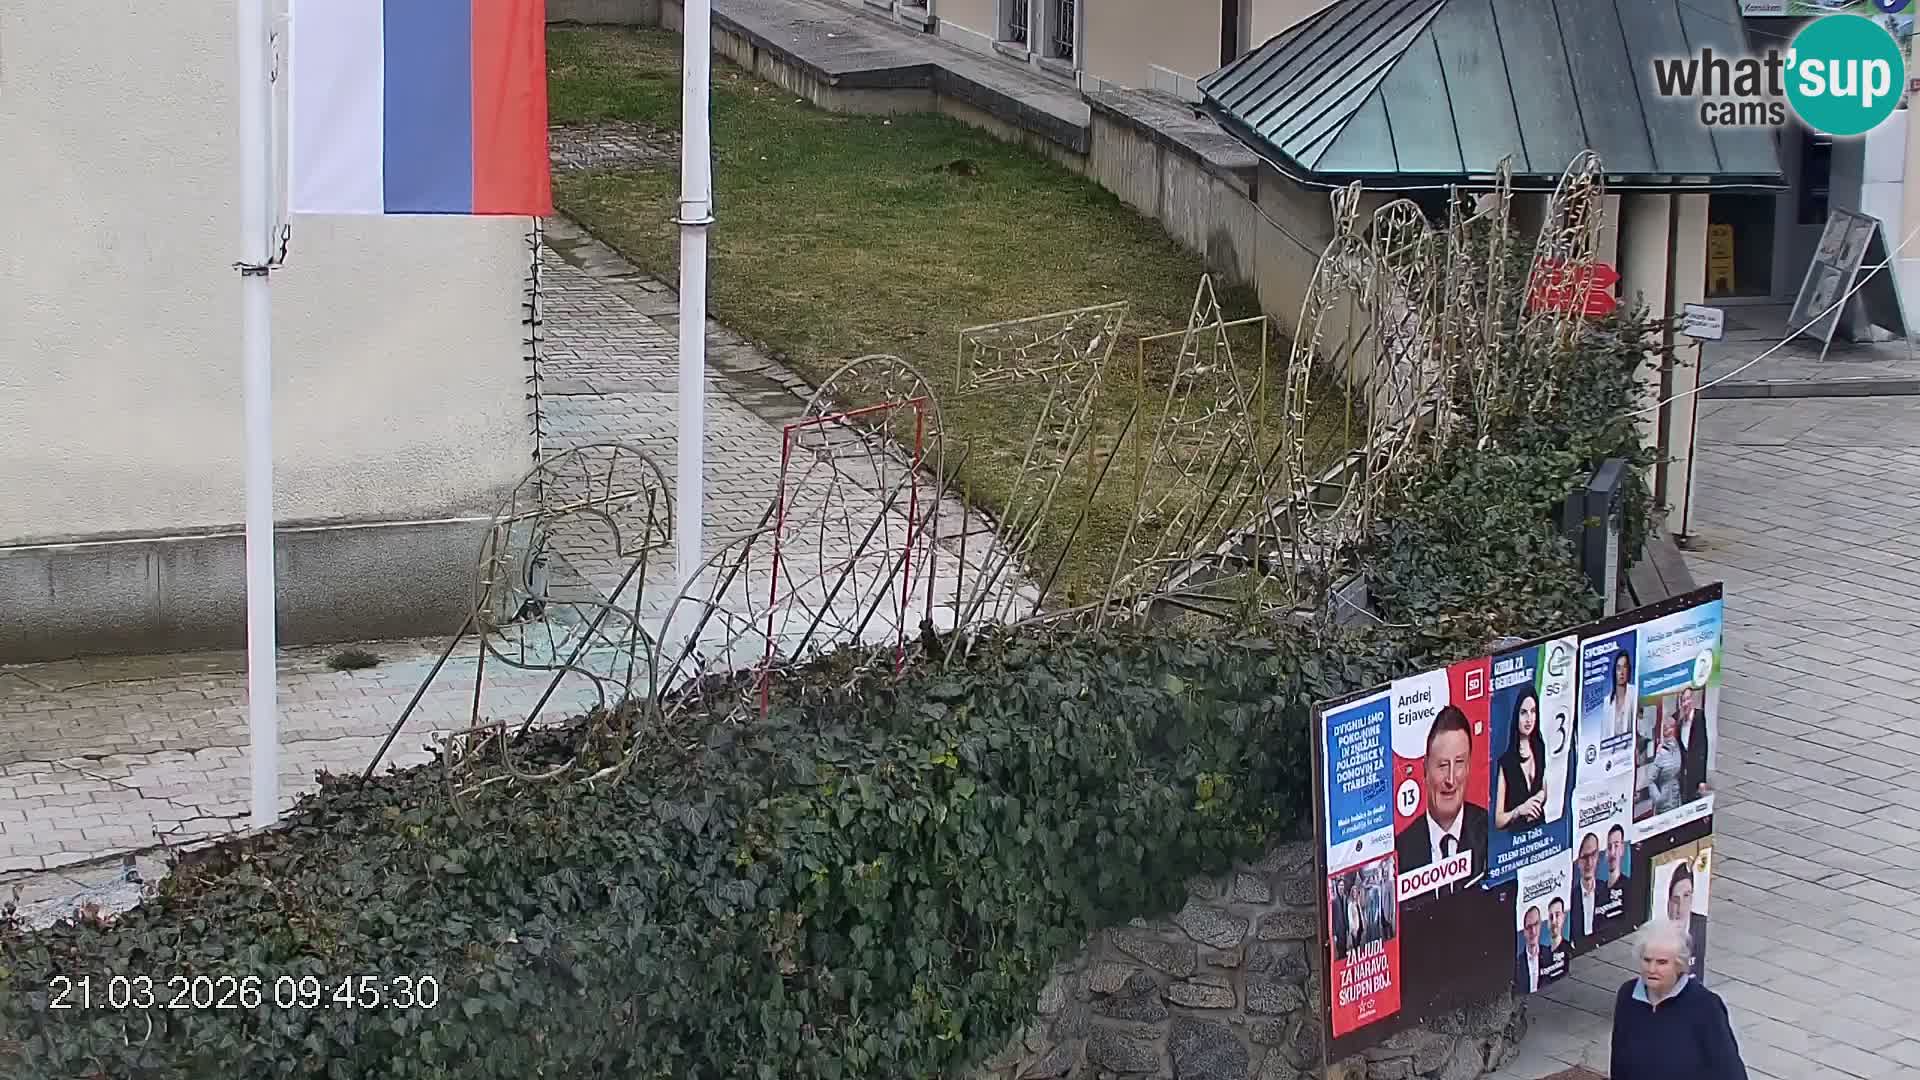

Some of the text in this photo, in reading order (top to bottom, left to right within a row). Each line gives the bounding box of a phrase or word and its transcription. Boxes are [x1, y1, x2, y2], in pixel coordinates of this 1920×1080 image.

[1469, 679, 1479, 690] SD
[1398, 687, 1431, 708] Andrej
[1334, 712, 1384, 737] DVIGNILI SMO
[1398, 706, 1435, 726] Erjavec
[1338, 724, 1380, 747] POKOJNINE
[1553, 712, 1566, 755] 3
[1342, 736, 1379, 758] IN ZNIŽALI
[1336, 747, 1384, 772] POLOŽNICE V
[1374, 759, 1385, 770] ZA
[1402, 789, 1415, 807] 13
[1512, 827, 1543, 846] Ana Taks
[1498, 851, 1519, 864] ZELENI
[1519, 839, 1549, 858] SLOVENIJE
[1401, 857, 1467, 895] DOGOVOR
[1500, 858, 1528, 875] STRANKA
[1346, 949, 1356, 967] ZA
[1340, 954, 1389, 987] ZA NARAVO.
[1338, 972, 1391, 1006] SKUPEN BOJ.
